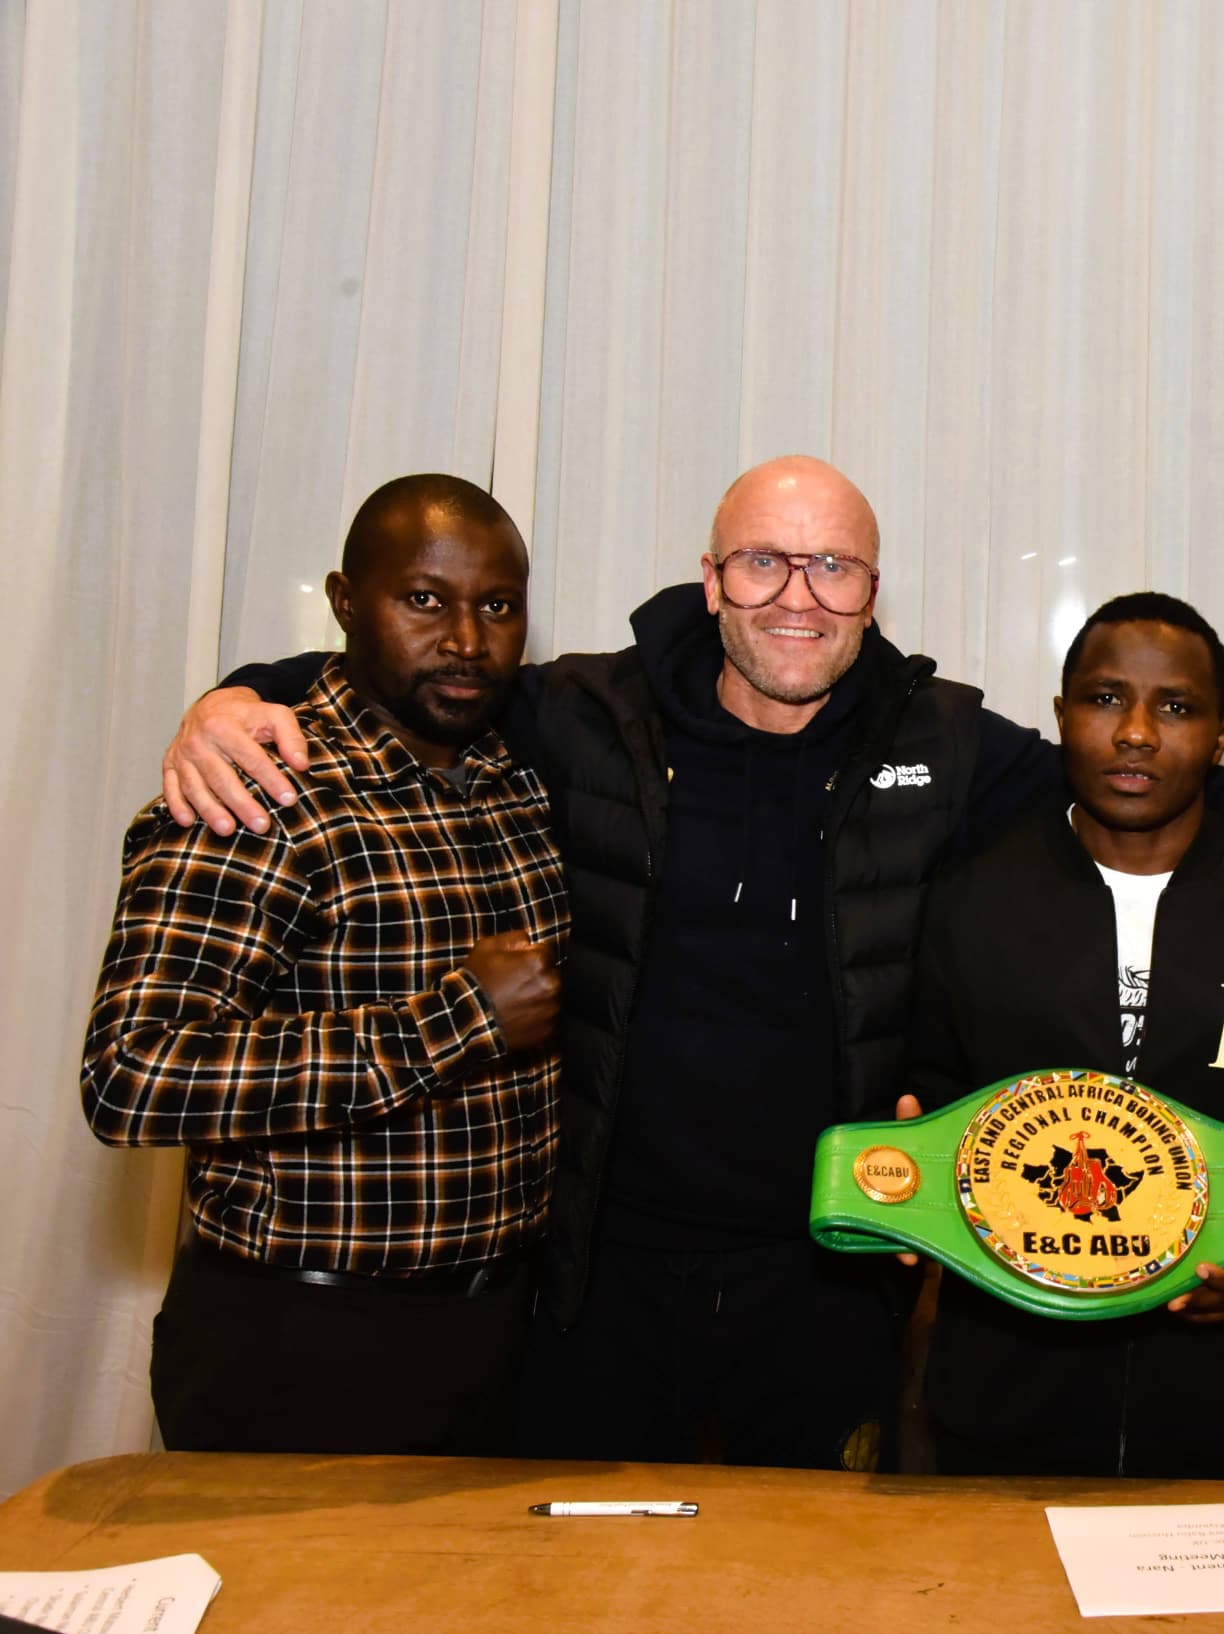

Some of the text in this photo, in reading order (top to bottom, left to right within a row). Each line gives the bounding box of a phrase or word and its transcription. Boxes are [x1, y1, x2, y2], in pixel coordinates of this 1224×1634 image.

[895, 764, 929, 776] North
[897, 774, 931, 787] Ridge
[974, 1084, 1193, 1191] EAST AND CENTRAL AFRICA BOXING UNION
[1001, 1107, 1165, 1176] REGIONAL CHAMPION
[867, 1165, 909, 1178] E&CABU
[1022, 1232, 1151, 1257] E&C ABU
[1136, 1564, 1175, 1573] Nara
